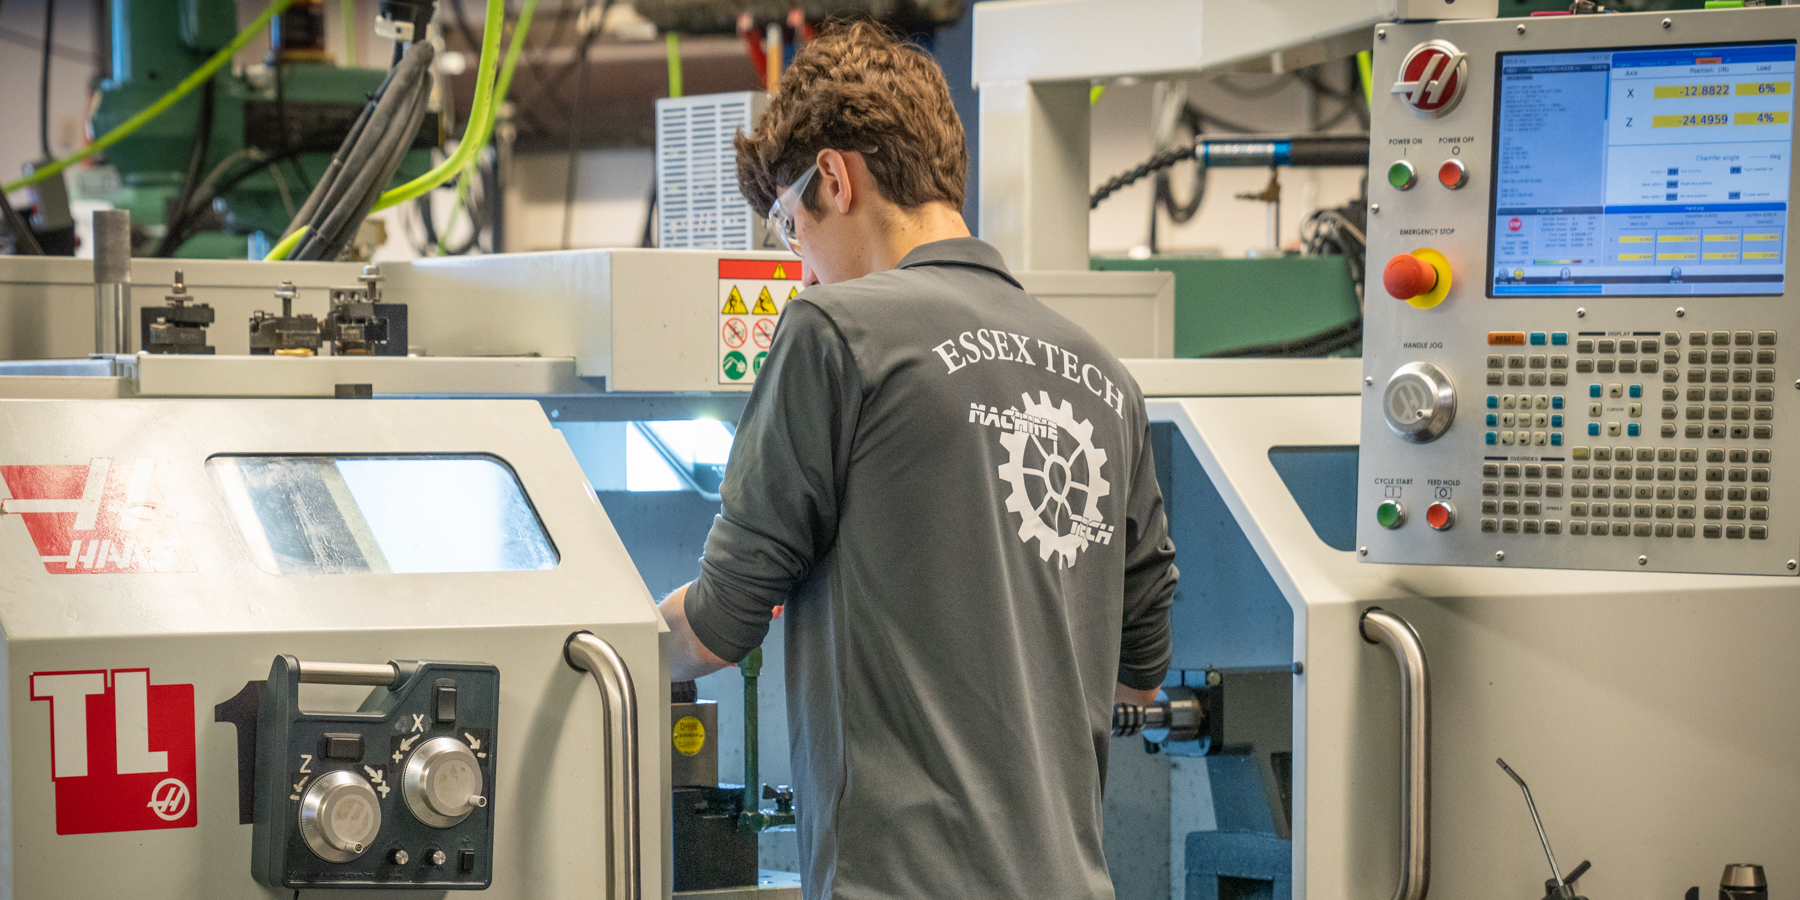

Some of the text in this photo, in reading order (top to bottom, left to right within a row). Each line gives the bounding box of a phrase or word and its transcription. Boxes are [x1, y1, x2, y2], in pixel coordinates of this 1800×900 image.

[1718, 66, 1730, 74] (IN)
[1756, 64, 1772, 72] Load
[1627, 88, 1634, 98] X
[1679, 84, 1730, 96] -12.8822
[1758, 83, 1776, 94] 6%
[1625, 117, 1633, 127] Z
[1678, 114, 1728, 126] -24.4959
[1757, 113, 1774, 123] 4%
[1695, 154, 1740, 162] Chamfer angle
[1769, 153, 1782, 161] deg
[1399, 228, 1438, 236] EMERGENCY
[932, 328, 1125, 420] ESSEX TECH
[968, 402, 1058, 441] MACHINE
[1442, 479, 1461, 487] HOLD
[1069, 513, 1115, 546] TECH
[411, 713, 425, 732] X
[32, 669, 267, 825] TL 1
[299, 754, 313, 774] Z
